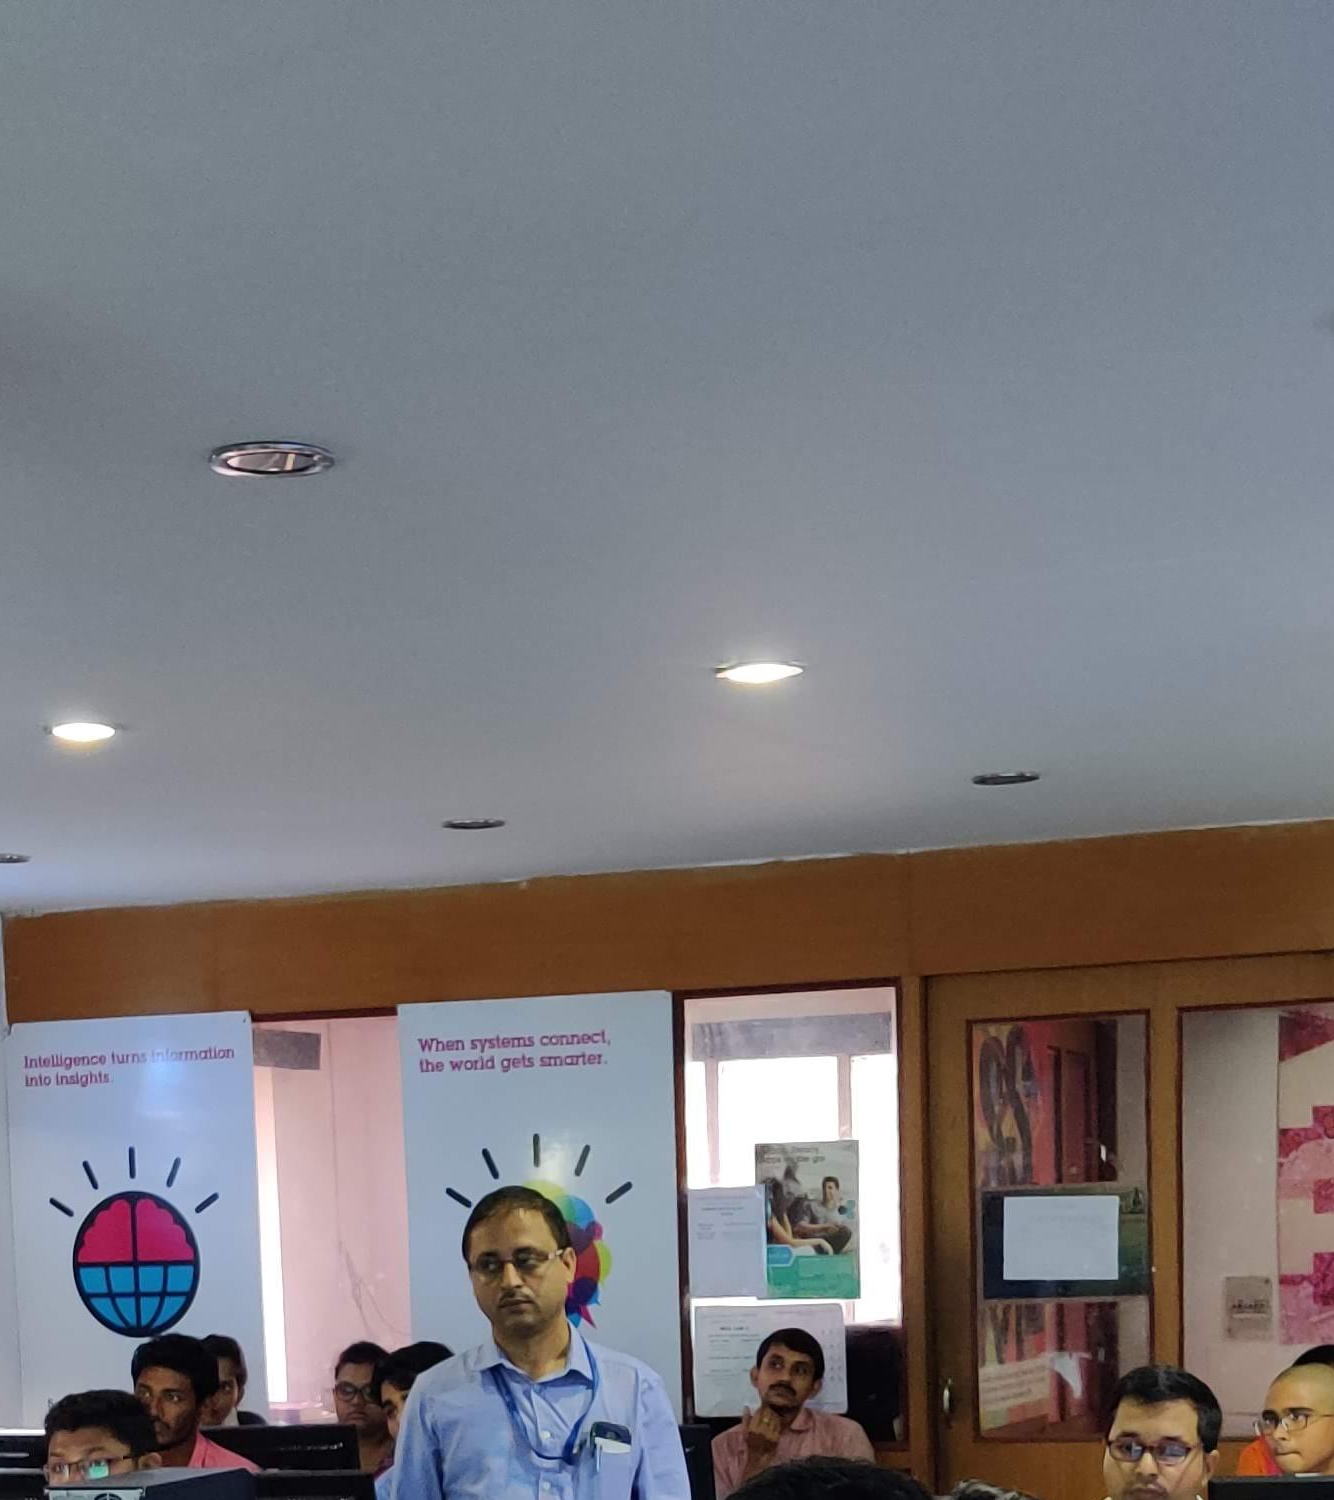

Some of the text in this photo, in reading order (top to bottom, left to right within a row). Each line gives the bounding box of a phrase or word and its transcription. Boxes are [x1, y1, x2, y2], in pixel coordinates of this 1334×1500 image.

[418, 1029, 611, 1053] When systems connect,
[24, 1047, 235, 1070] Intelligence turns information
[419, 1051, 607, 1073] the world gets smarter.
[25, 1073, 51, 1087] into
